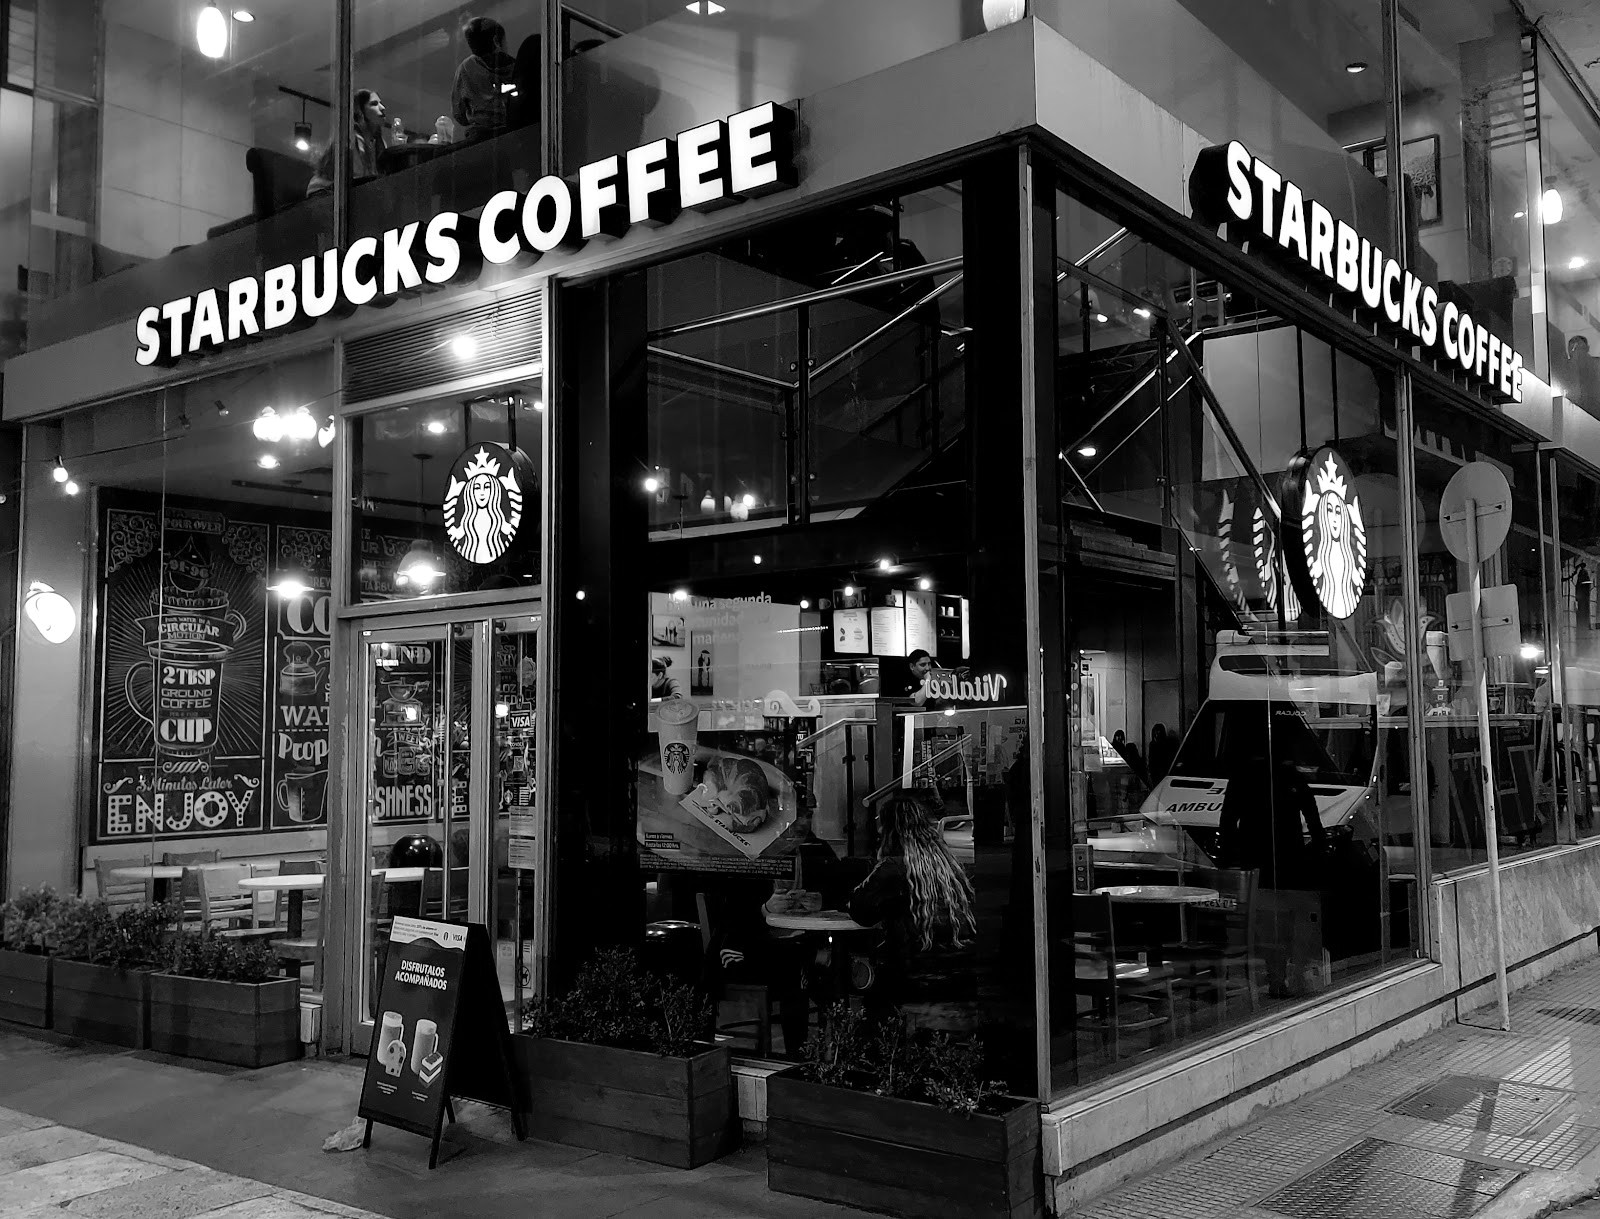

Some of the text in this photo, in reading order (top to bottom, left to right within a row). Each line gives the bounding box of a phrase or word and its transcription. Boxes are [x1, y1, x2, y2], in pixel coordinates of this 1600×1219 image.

[135, 101, 778, 367] STARBUCKS COFFEE
[1227, 139, 1523, 403] STARBUCKS COFFEE
[286, 595, 331, 636] CO
[158, 622, 220, 638] CIRCULAR
[167, 632, 206, 640] MOTION
[163, 666, 216, 685] 2 TBSP
[160, 698, 212, 709] COFFEE
[161, 688, 213, 698] GROUND
[280, 705, 330, 727] WAT
[511, 716, 531, 728] VISA
[160, 718, 212, 743] CUP
[278, 732, 330, 766] Prop
[375, 783, 432, 818] SHNESS
[1166, 802, 1225, 813] AMBU
[107, 789, 254, 835] ENJOY
[401, 959, 446, 978] DISFRUTALOS
[394, 970, 448, 991] ACOMPAÑADOS
